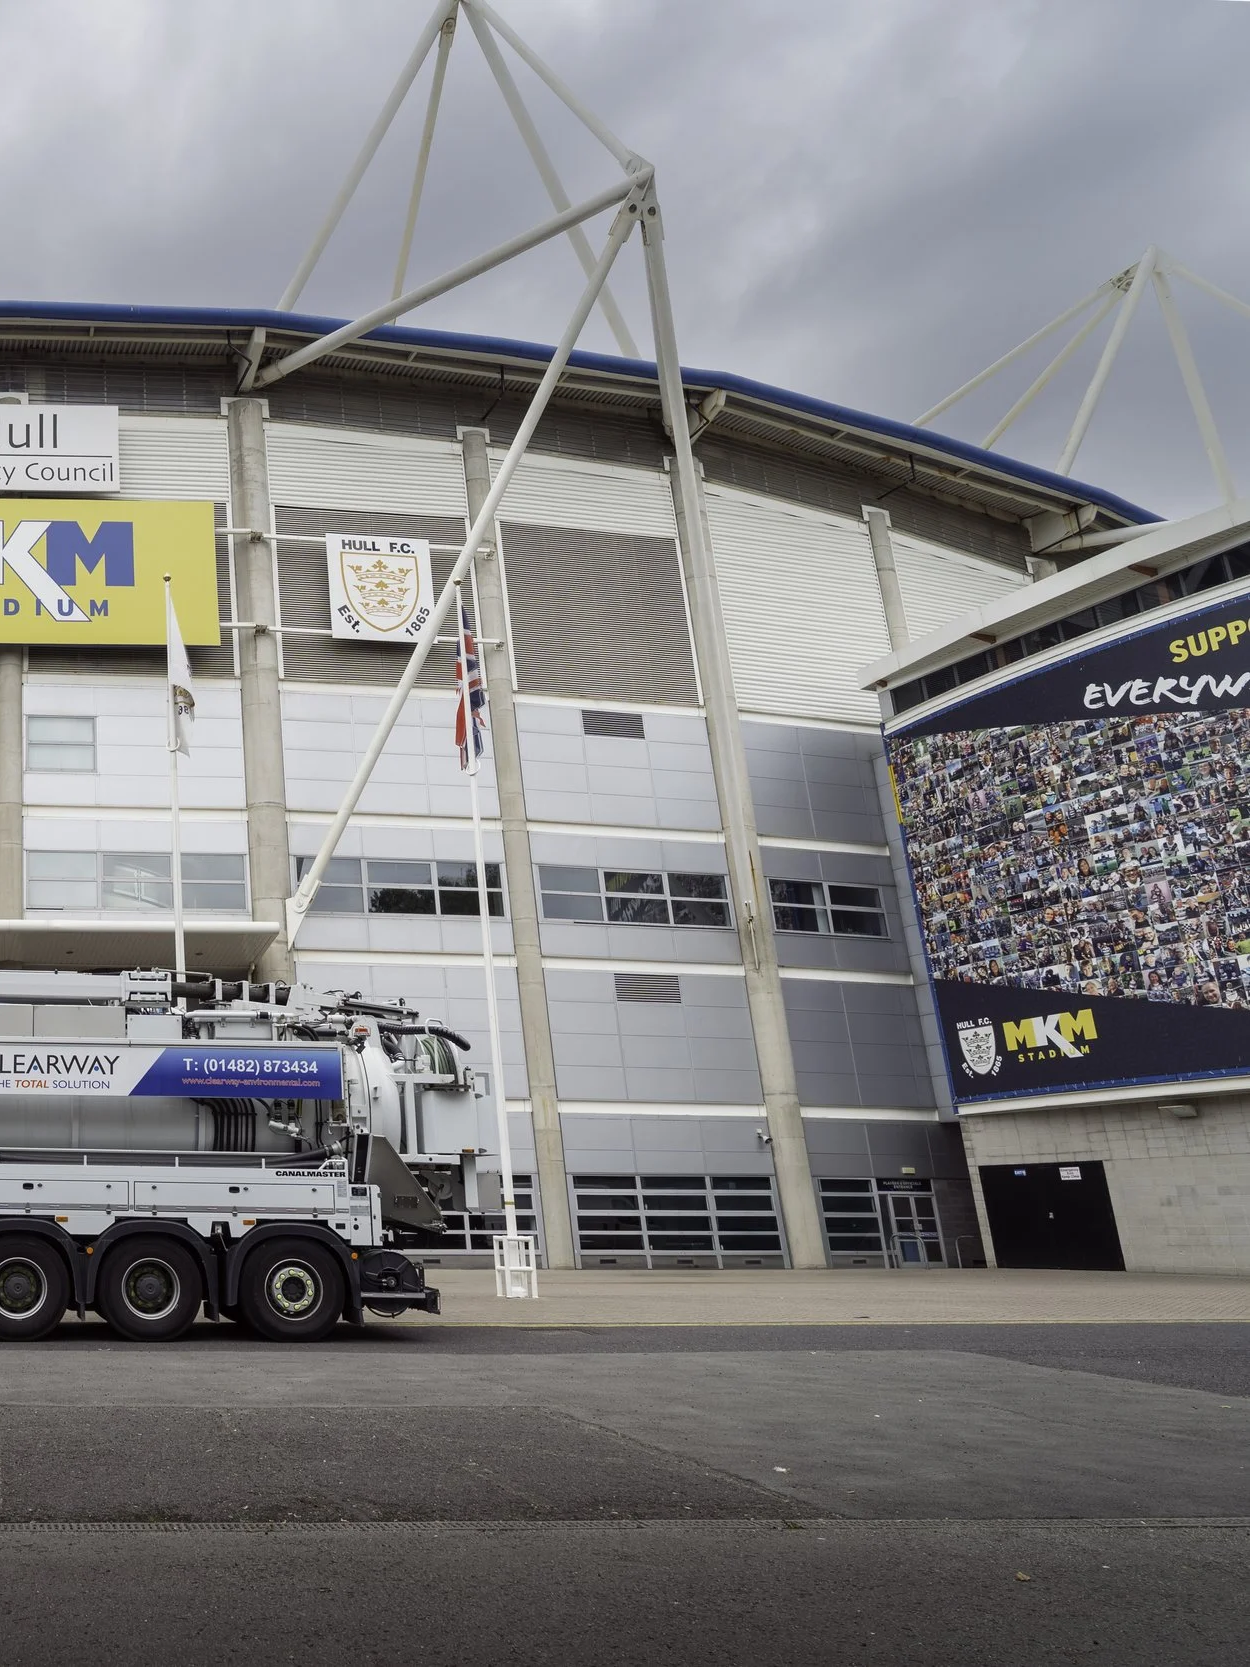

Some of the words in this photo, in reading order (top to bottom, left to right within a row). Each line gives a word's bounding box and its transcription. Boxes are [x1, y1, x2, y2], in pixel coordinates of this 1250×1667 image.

[25, 462, 115, 483] Council
[341, 539, 381, 552] HULL
[389, 542, 415, 554] F.C.
[337, 604, 361, 634] Est.
[405, 606, 431, 637] 1865
[1169, 618, 1250, 663] SUPP
[956, 1020, 975, 1030] HULL
[978, 1017, 992, 1026] F.C.
[1002, 1008, 1098, 1059] MKM
[1018, 1045, 1090, 1063] STADIUM
[183, 1058, 198, 1071] T:
[203, 1058, 259, 1075] (01482)
[263, 1060, 319, 1074] 873434
[15, 1080, 49, 1088] TOTAL
[52, 1080, 110, 1089] SOLUTION
[181, 1077, 320, 1088] www.clearway-environmental.com
[275, 1170, 346, 1178] CANALMASTER
